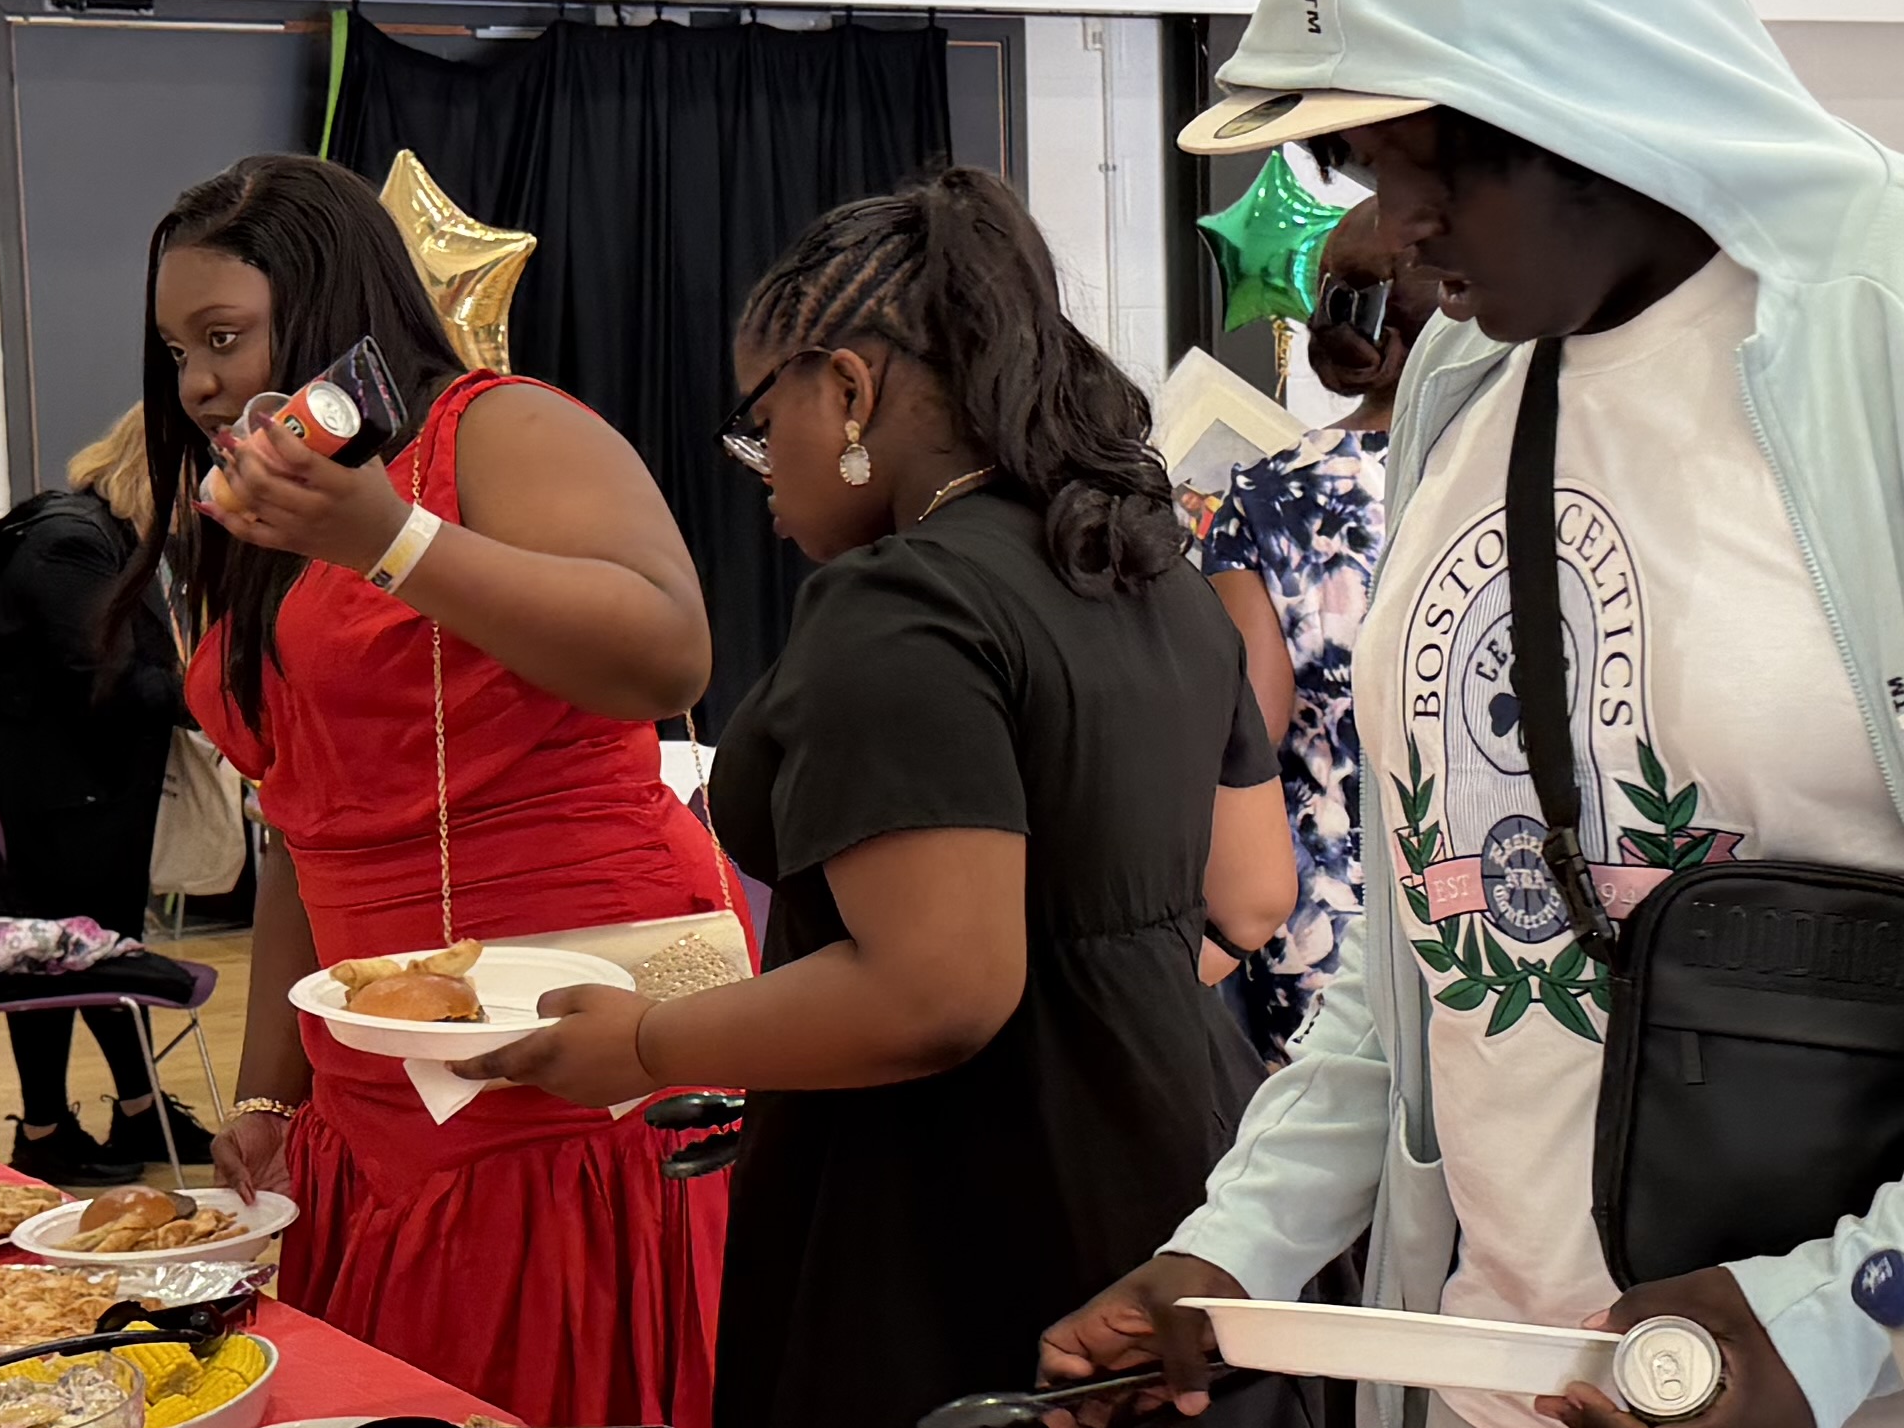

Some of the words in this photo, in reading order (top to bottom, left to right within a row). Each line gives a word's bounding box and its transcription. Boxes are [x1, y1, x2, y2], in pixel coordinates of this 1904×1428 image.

[1412, 528, 1505, 722] BOSTO
[1555, 502, 1635, 728] CELTICS
[1432, 874, 1470, 904] EST
